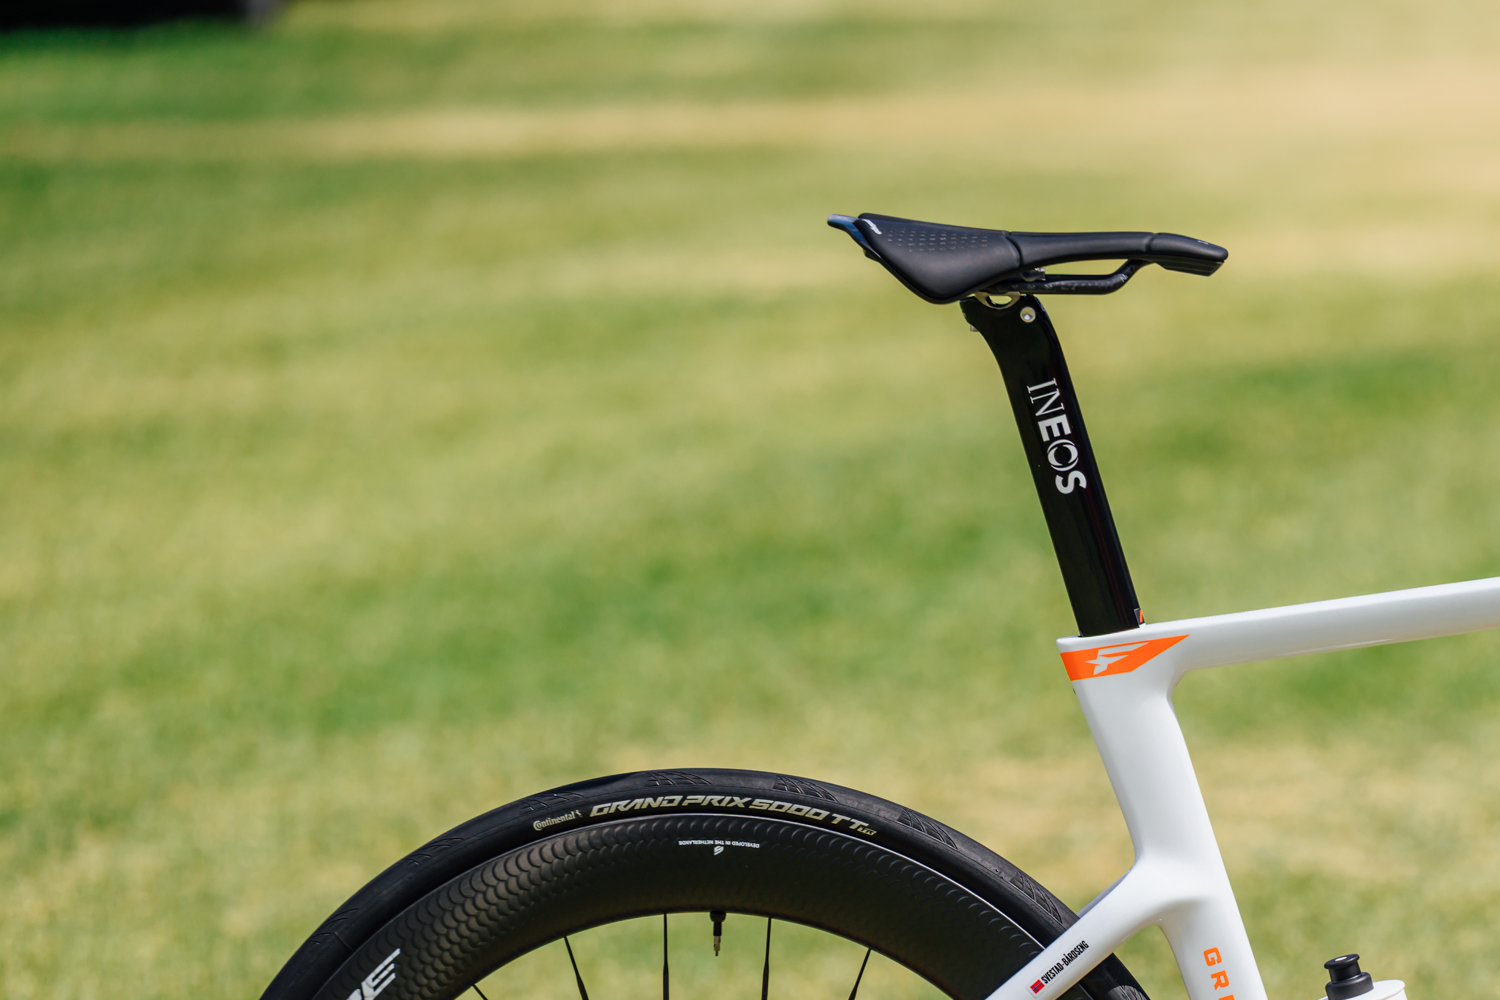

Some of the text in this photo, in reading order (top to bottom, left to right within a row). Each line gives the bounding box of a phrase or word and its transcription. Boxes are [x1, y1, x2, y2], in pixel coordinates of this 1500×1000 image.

[1027, 378, 1087, 494] INEOS
[533, 810, 577, 831] Continental
[589, 796, 683, 817] GRAND
[682, 795, 752, 807] PRIX
[749, 799, 830, 820] 5000
[1041, 940, 1090, 984] SVESTAD-BÅRDSENG
